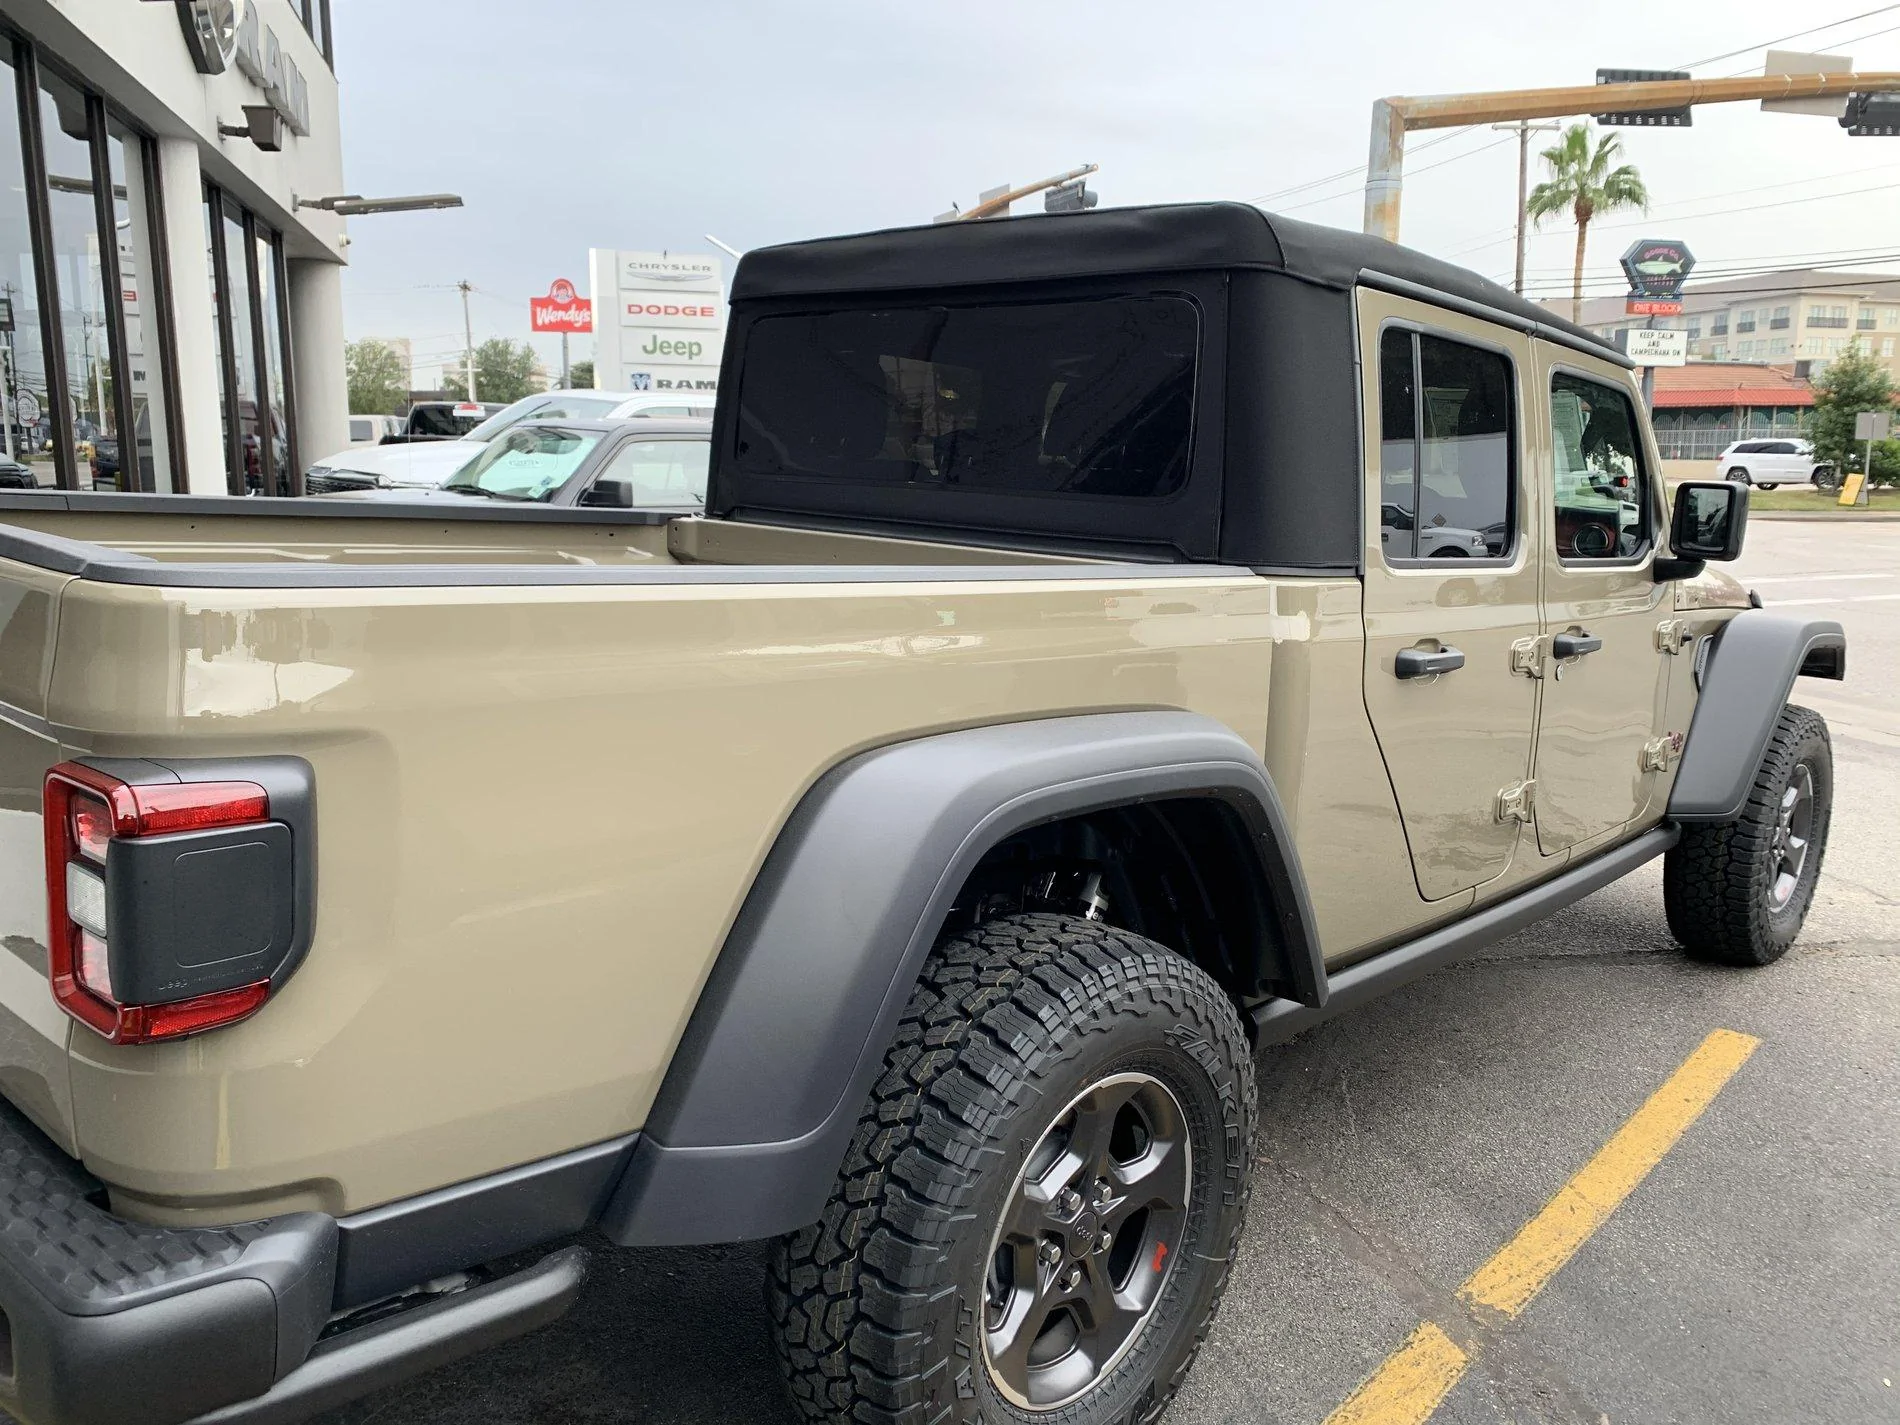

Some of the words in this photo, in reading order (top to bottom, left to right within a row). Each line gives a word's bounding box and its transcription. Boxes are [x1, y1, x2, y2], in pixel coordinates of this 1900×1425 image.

[628, 262, 712, 272] CHRYSLER
[627, 303, 715, 317] DODGE
[1634, 303, 1651, 312] ONE
[1652, 304, 1677, 312] BLOCK
[536, 304, 591, 327] Wendy's
[1640, 331, 1655, 339] KEEP
[642, 334, 703, 360] Jeep
[656, 378, 717, 391] RAM
